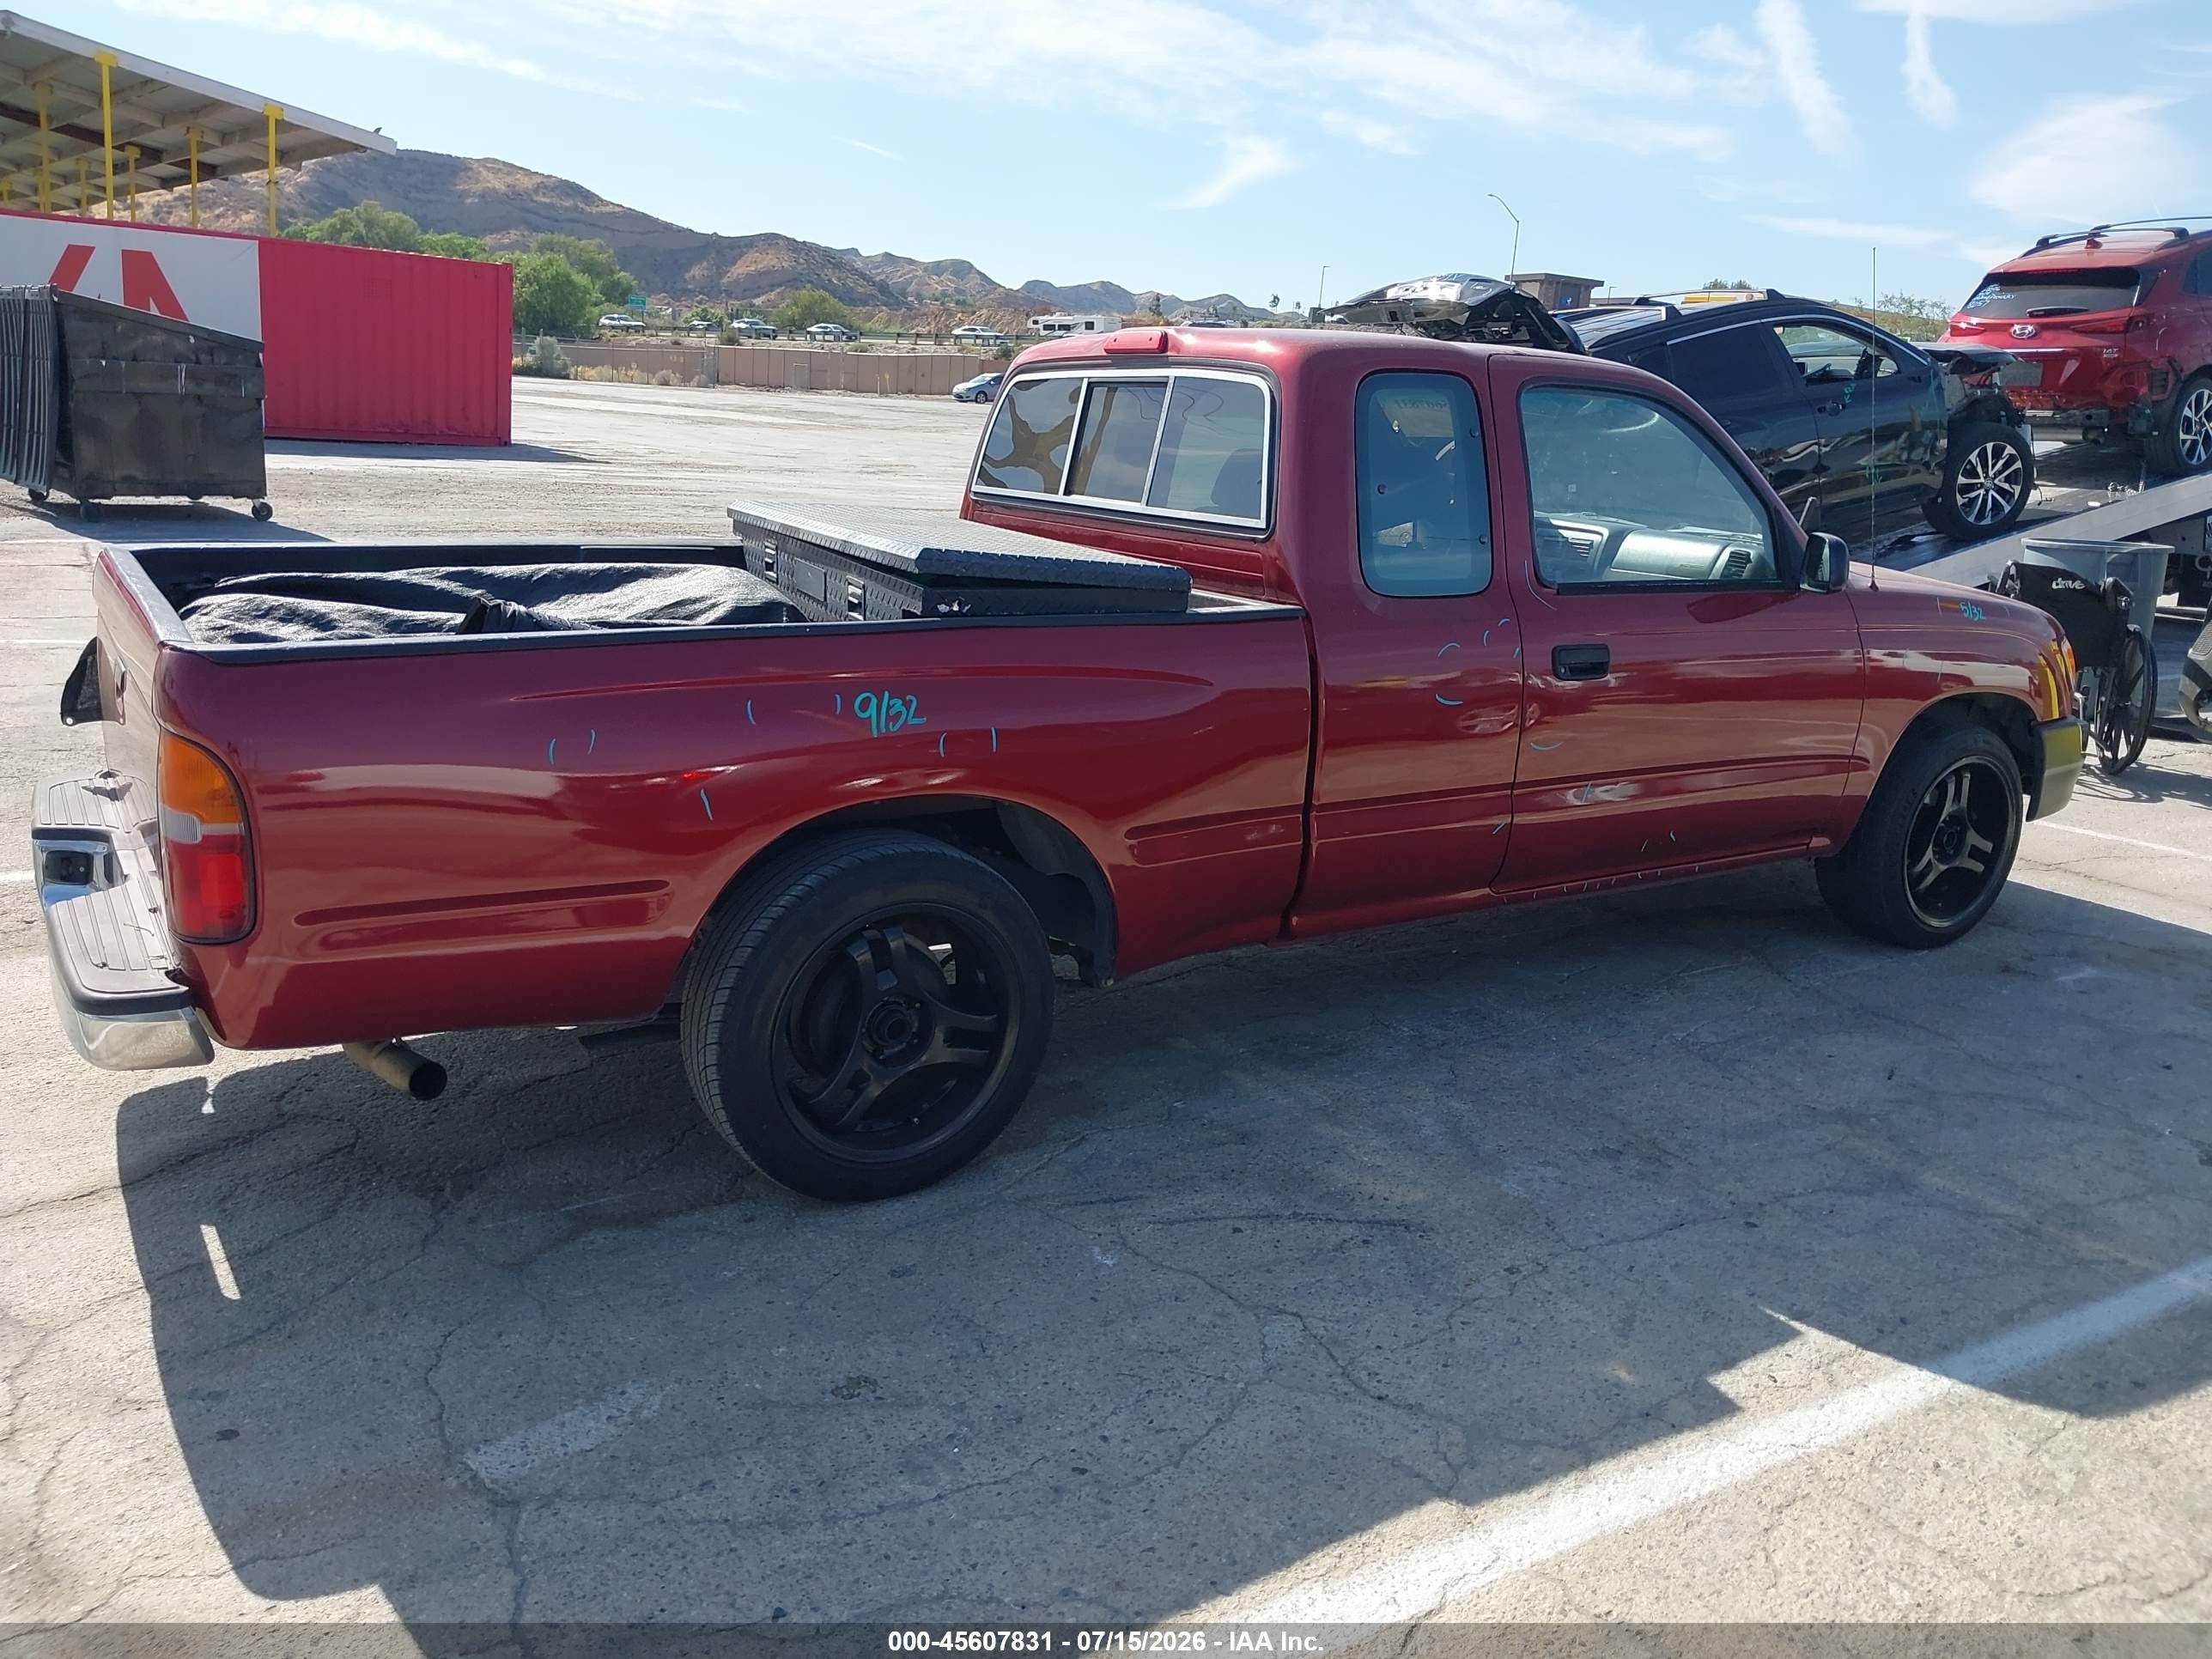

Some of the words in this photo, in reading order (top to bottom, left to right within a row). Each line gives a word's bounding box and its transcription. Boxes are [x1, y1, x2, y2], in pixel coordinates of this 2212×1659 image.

[2051, 577, 2086, 590] drive
[1959, 601, 1986, 621] 5/32
[854, 690, 927, 738] 9/32
